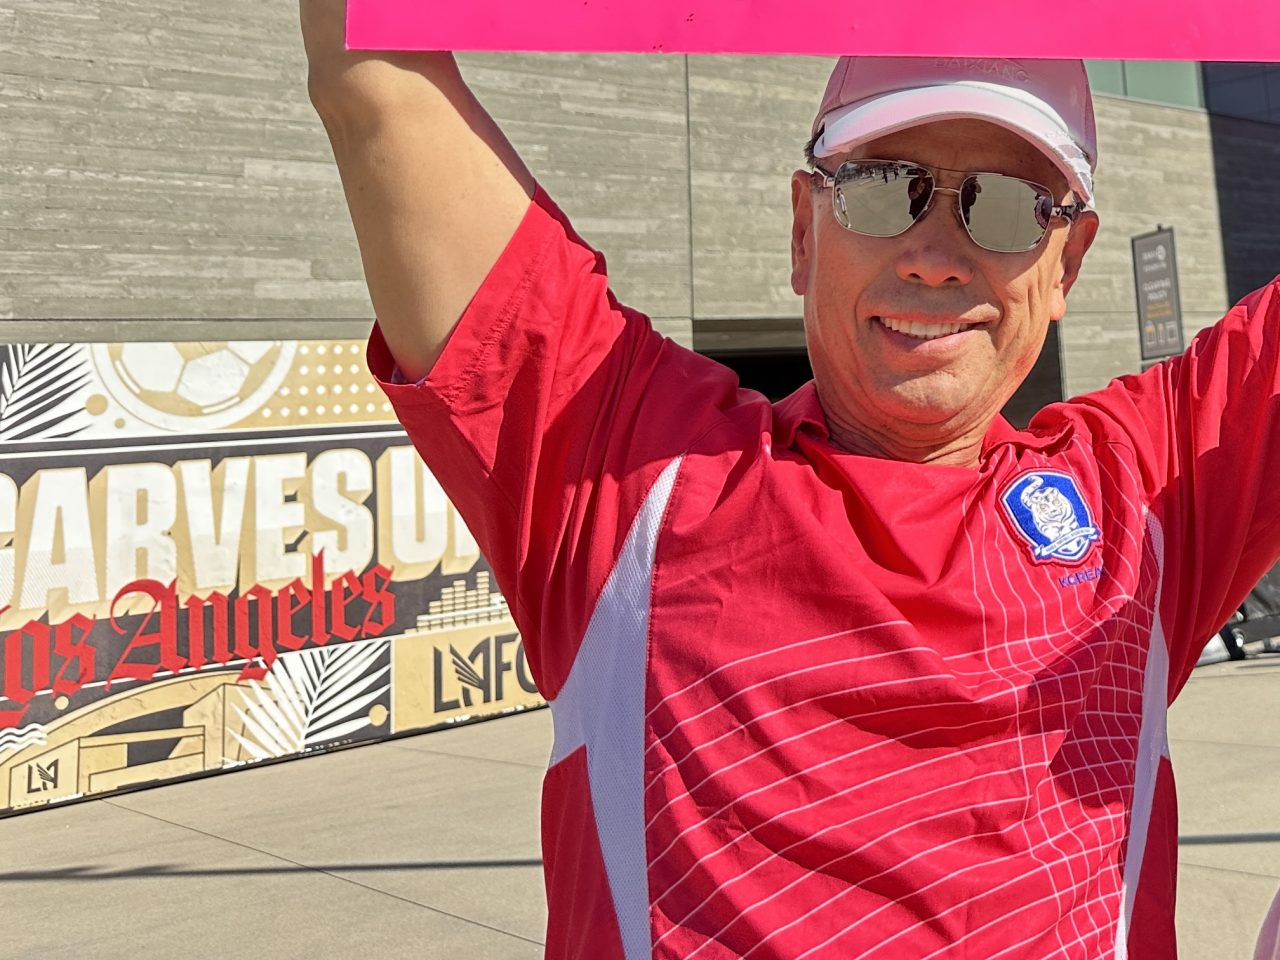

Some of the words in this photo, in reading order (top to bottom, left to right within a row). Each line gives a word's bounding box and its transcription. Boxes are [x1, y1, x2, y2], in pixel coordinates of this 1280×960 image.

[0, 448, 374, 615] ARVES
[1058, 565, 1104, 588] KOREA
[105, 548, 396, 692] Angeles
